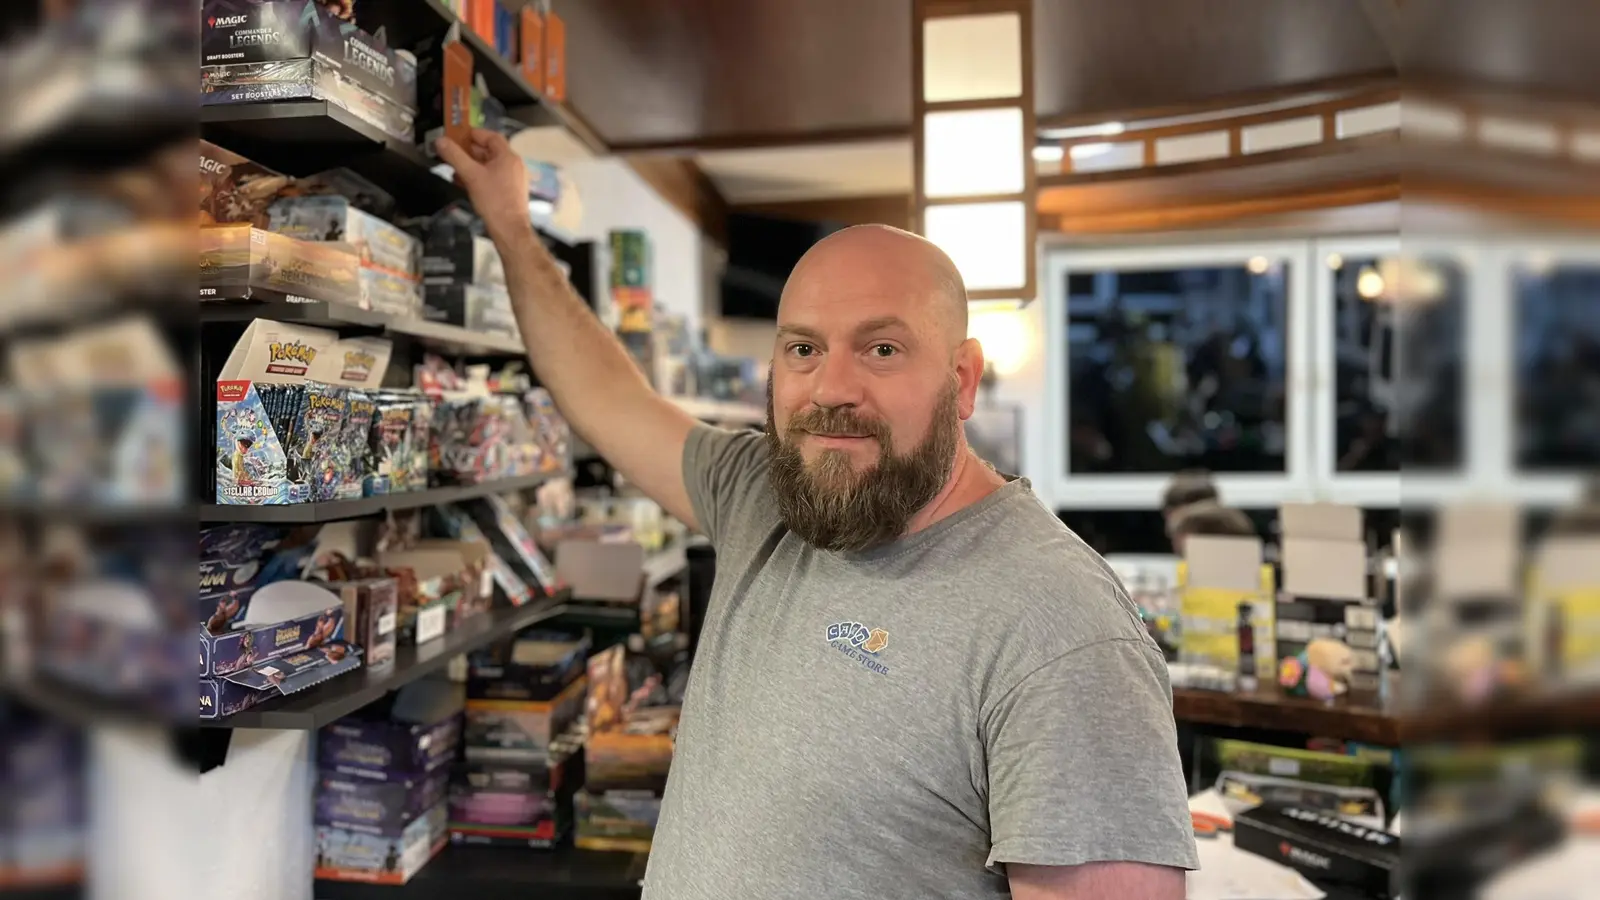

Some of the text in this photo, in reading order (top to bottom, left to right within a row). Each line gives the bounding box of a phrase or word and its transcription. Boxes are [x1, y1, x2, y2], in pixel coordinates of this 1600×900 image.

[215, 15, 248, 26] MAGIC
[234, 27, 273, 37] COMMANDER
[229, 31, 281, 49] LEGENDS
[343, 39, 395, 88] LEGENDS
[245, 89, 281, 100] BOOSTERS
[223, 485, 278, 497] STELLAR CROWN
[830, 640, 890, 676] GAME STORE
